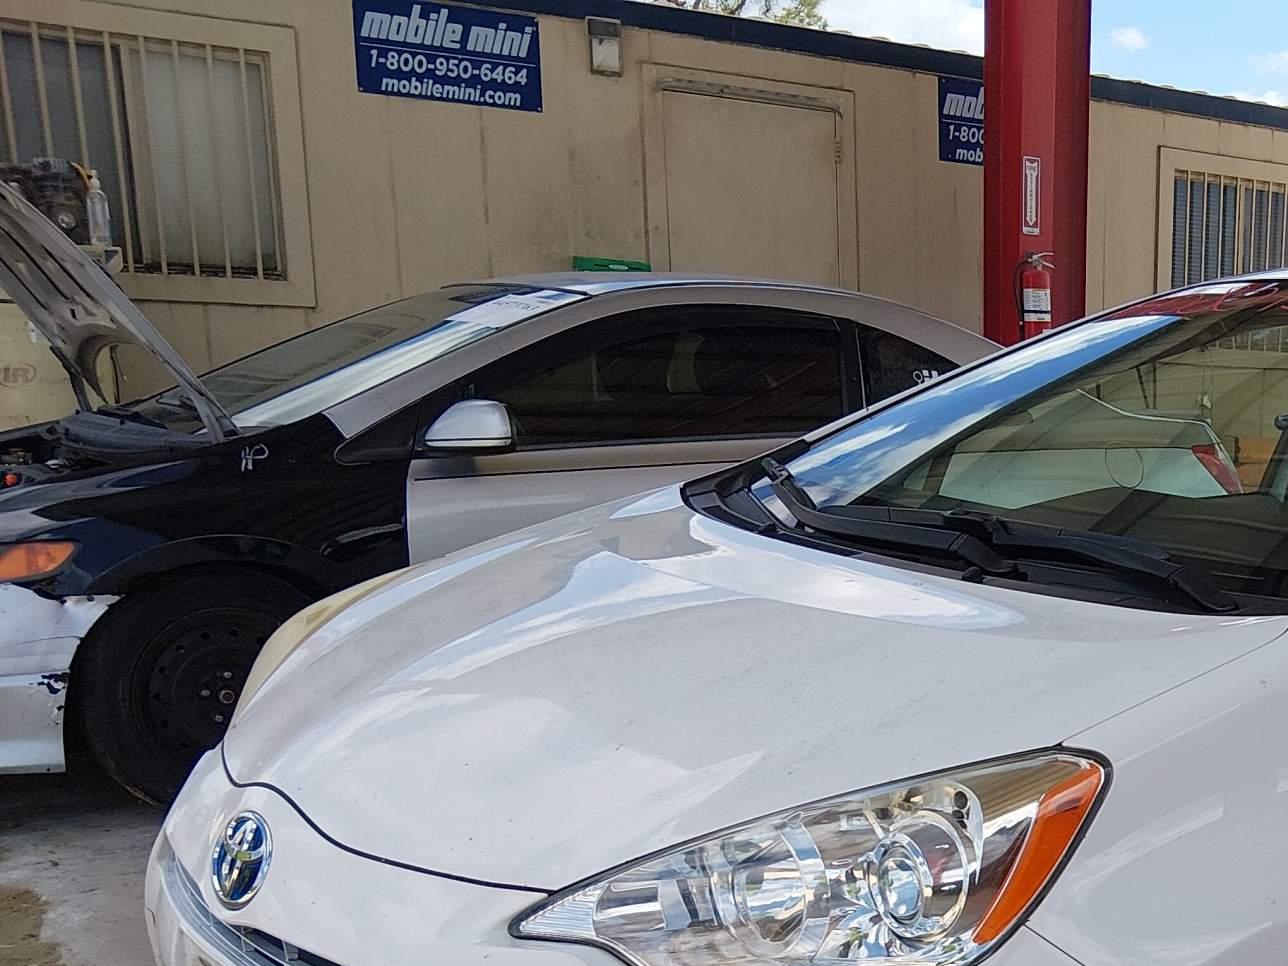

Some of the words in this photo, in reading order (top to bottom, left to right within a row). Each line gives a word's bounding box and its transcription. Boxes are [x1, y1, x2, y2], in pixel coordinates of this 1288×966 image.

[359, 4, 464, 49] mobile
[466, 22, 534, 58] mini
[369, 49, 528, 86] 1-800-950-6464
[380, 76, 521, 107] mobilemini.com
